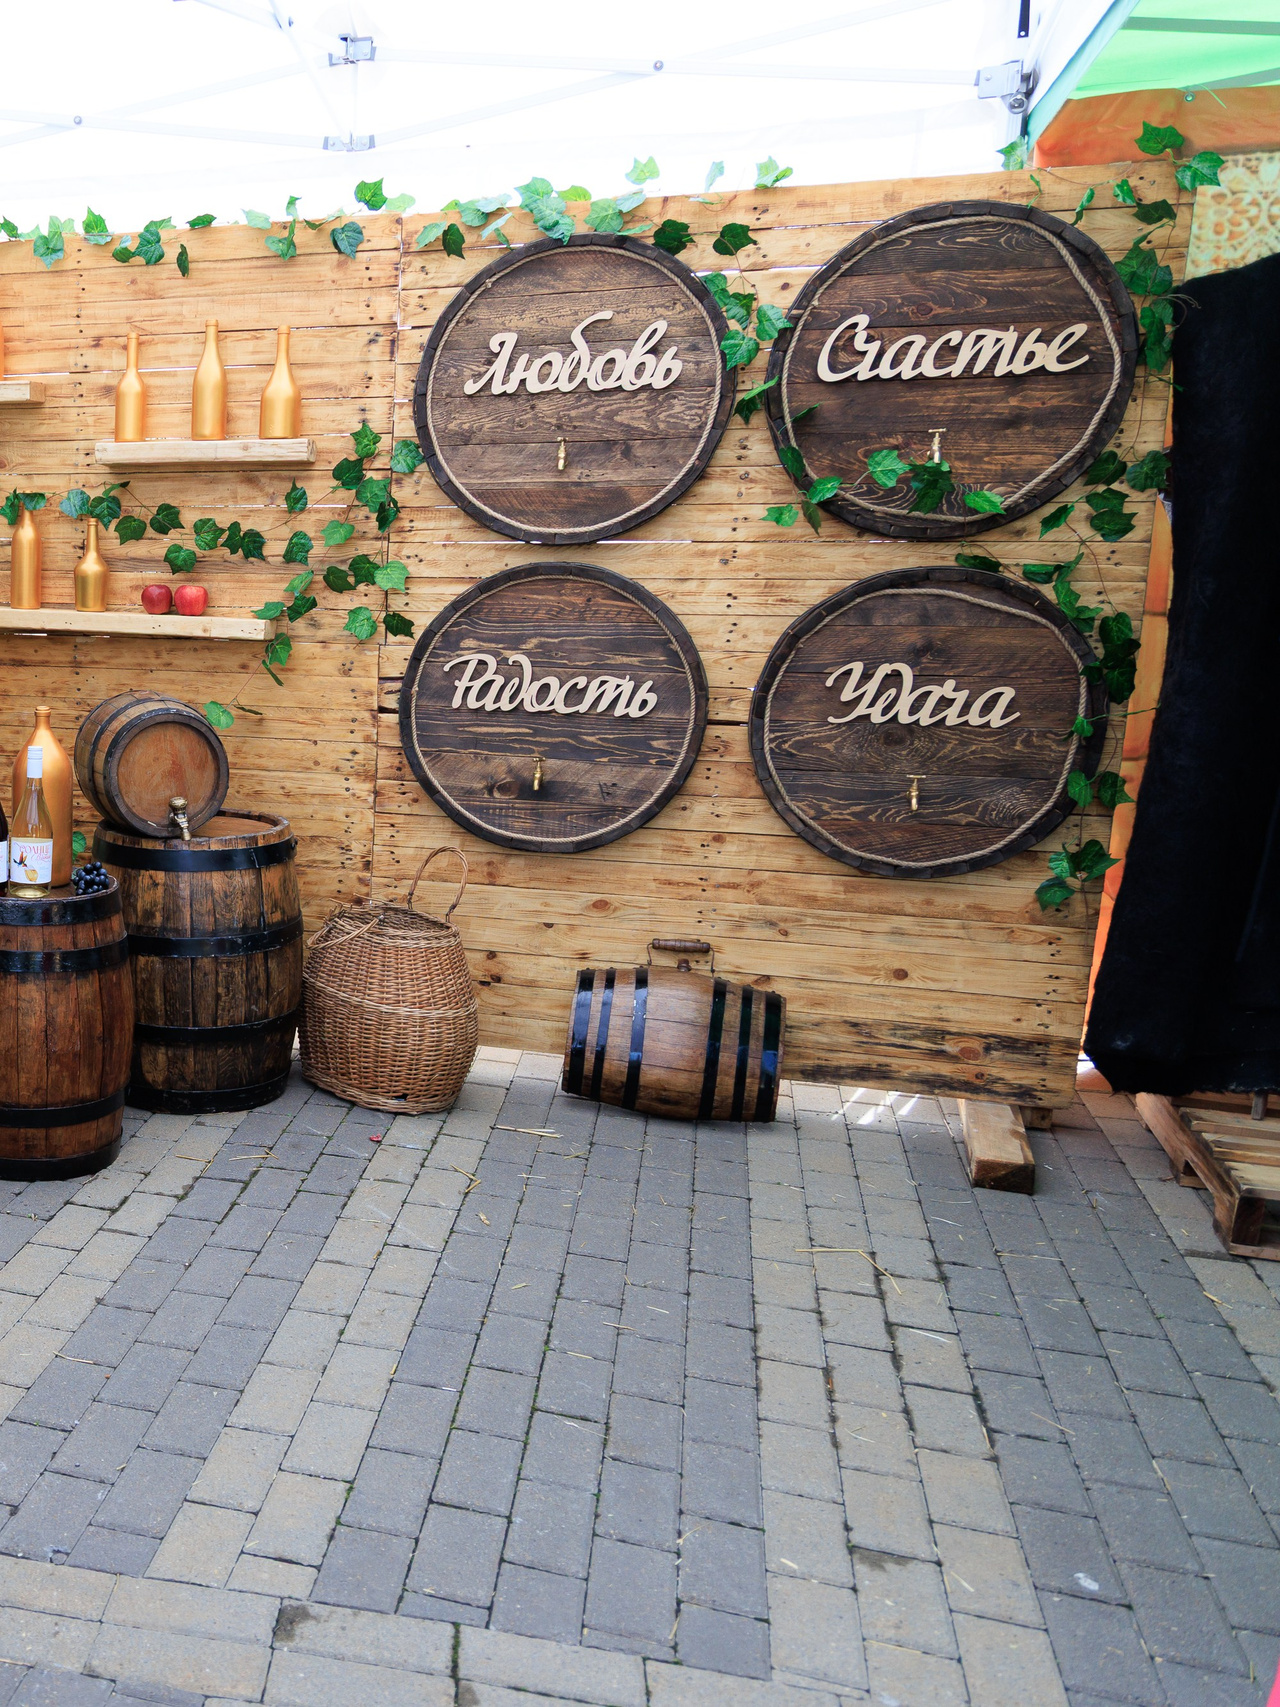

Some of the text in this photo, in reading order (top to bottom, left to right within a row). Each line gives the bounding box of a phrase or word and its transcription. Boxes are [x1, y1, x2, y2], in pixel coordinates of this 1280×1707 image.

[463, 310, 683, 396] Любовь
[817, 313, 1090, 382] Счастье
[442, 653, 658, 718] Радость
[825, 661, 1021, 728] Удача
